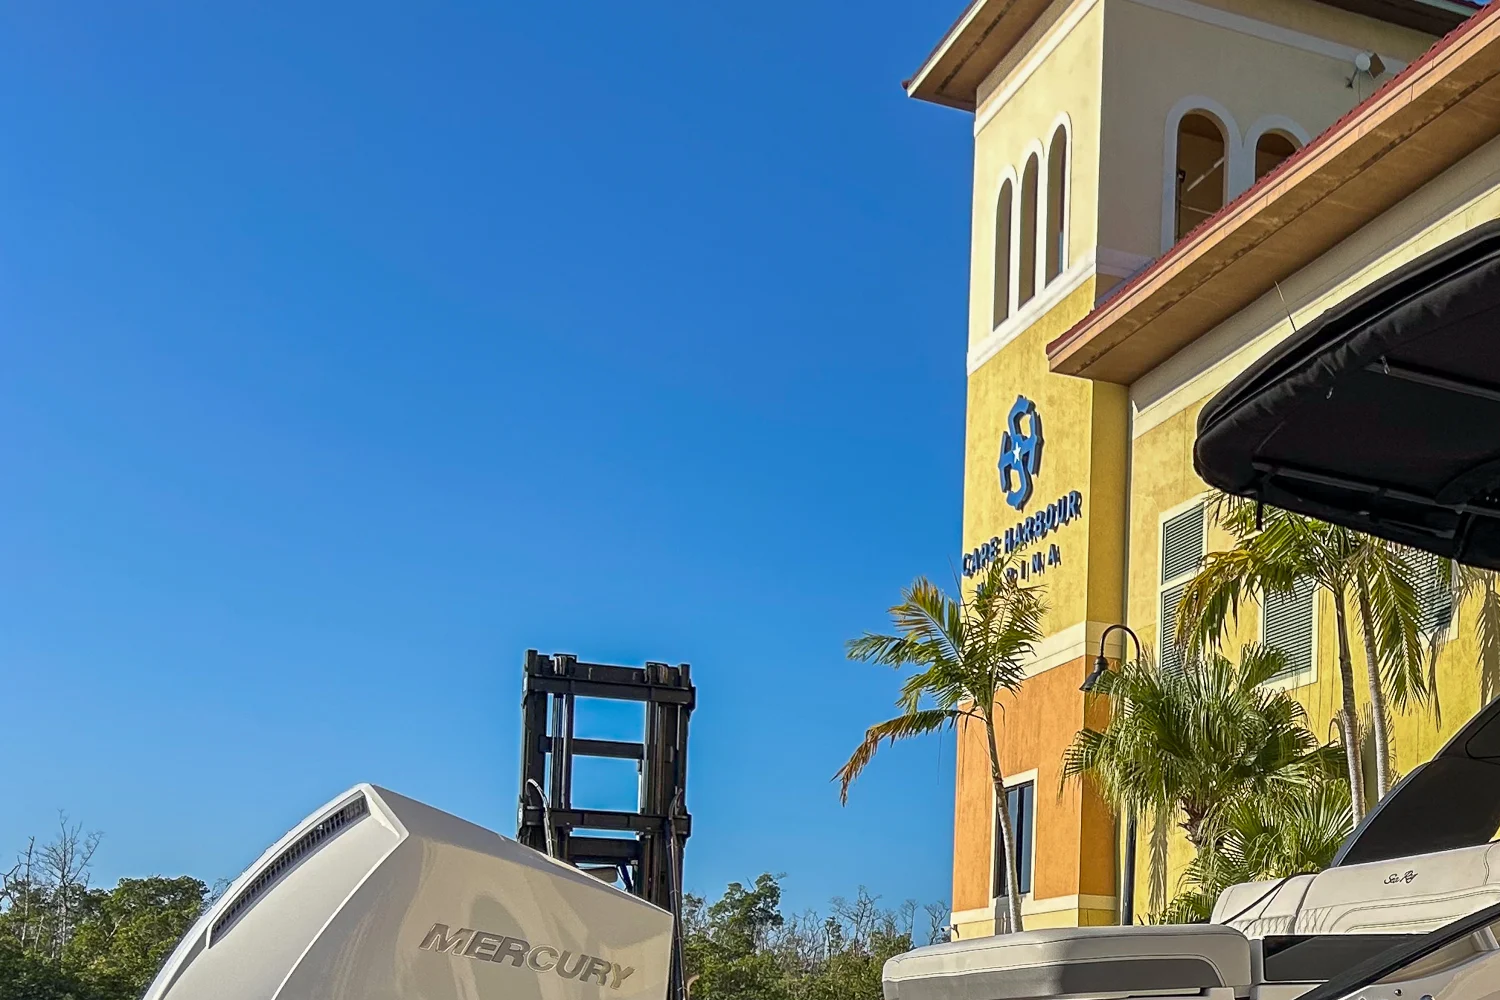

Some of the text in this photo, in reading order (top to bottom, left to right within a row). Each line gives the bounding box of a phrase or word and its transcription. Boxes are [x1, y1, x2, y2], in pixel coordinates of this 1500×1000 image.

[962, 490, 1083, 579] CAPE HARBOUR
[976, 543, 1062, 598] RINA
[418, 922, 636, 990] MERCURY
